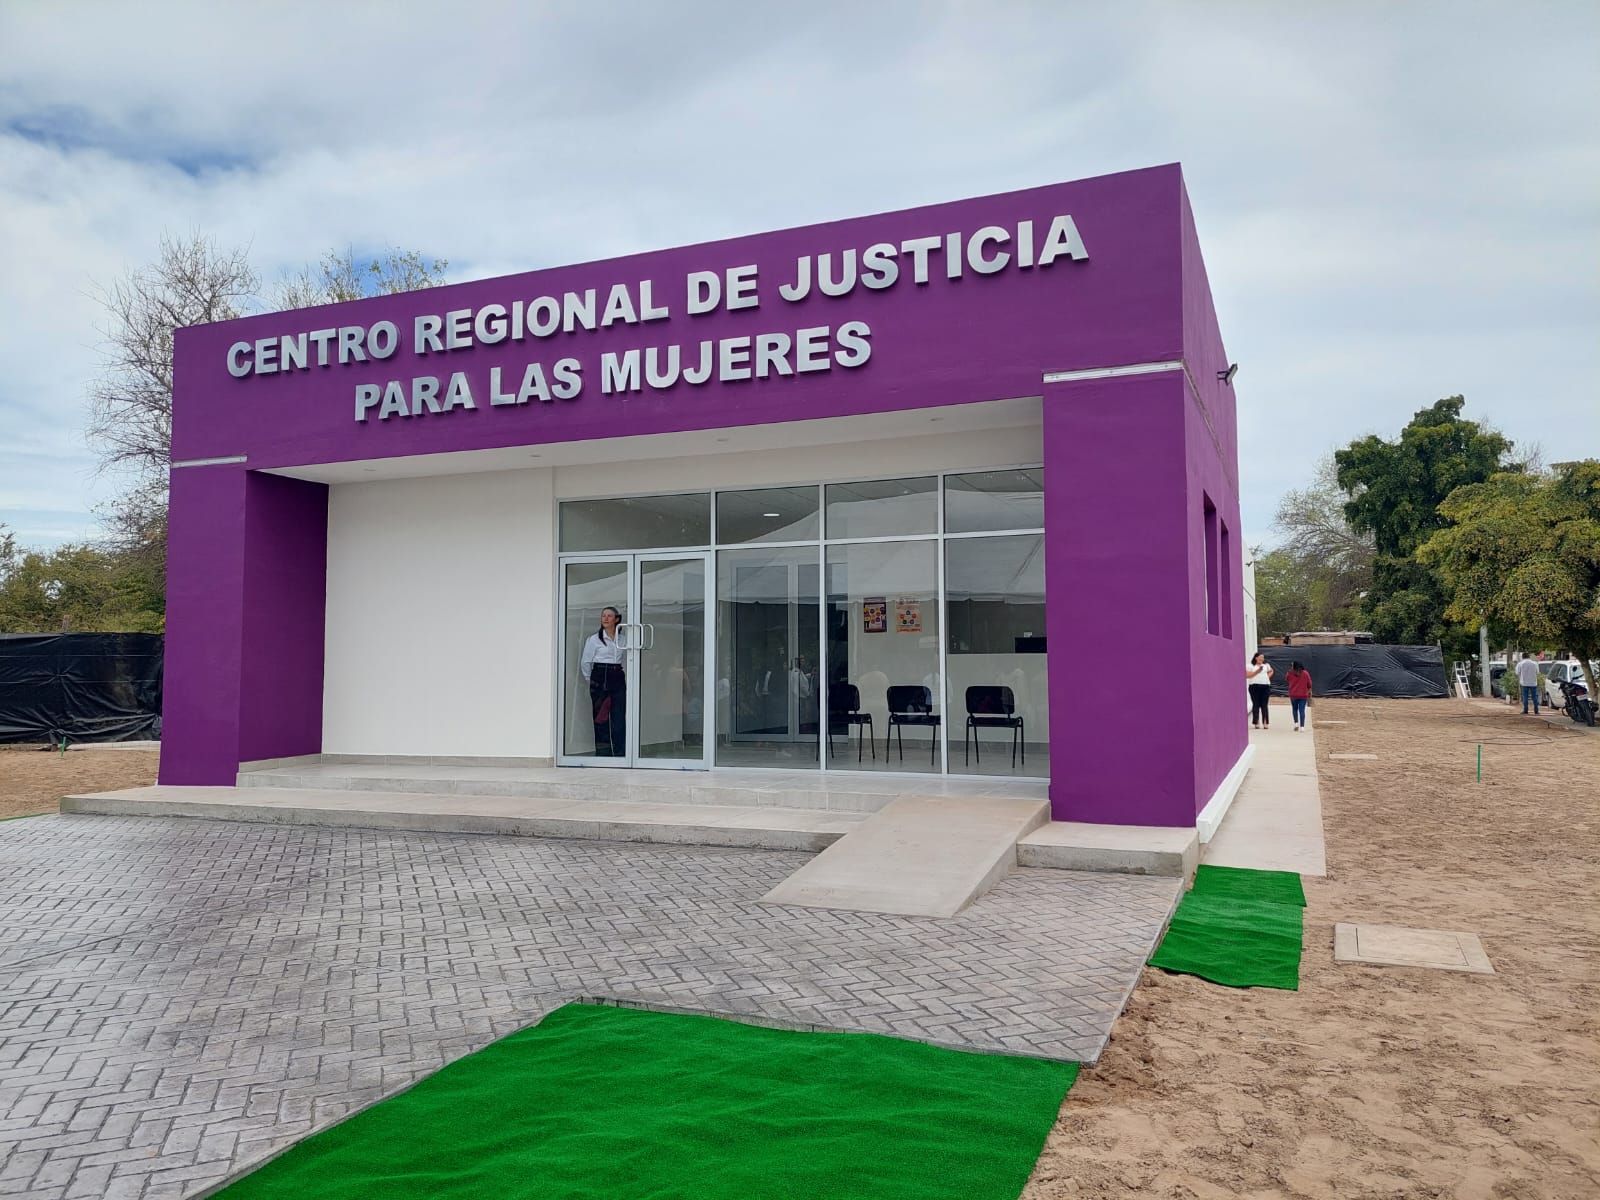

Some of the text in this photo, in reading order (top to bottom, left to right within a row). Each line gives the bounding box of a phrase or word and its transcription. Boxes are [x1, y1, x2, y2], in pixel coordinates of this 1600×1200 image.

[226, 214, 1090, 378] CENTRO REGIONAL DE JUSTICIA
[353, 320, 873, 422] PARA LAS MUJERES
